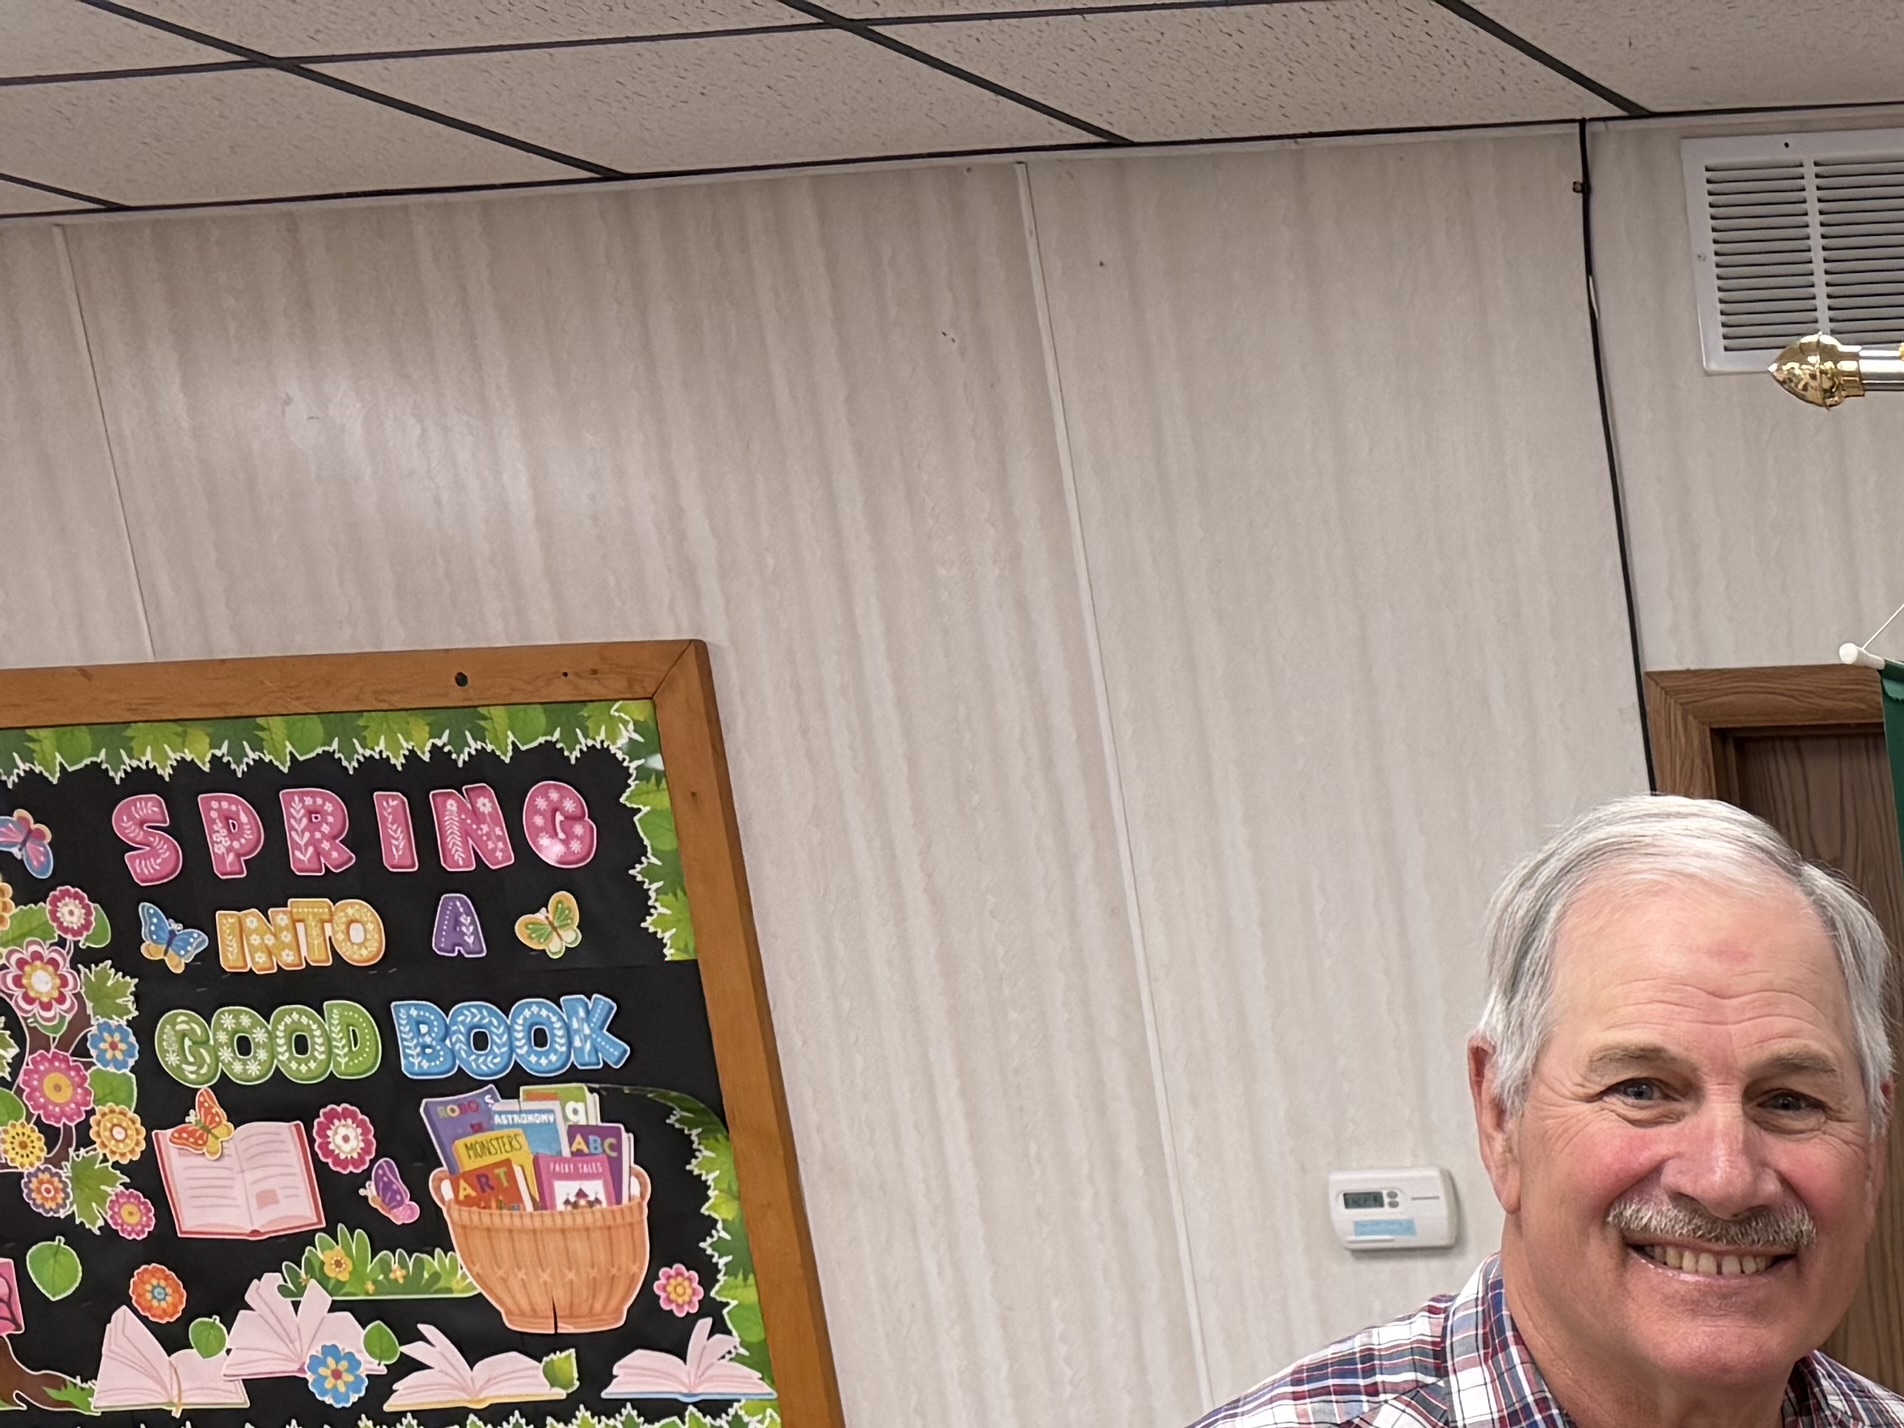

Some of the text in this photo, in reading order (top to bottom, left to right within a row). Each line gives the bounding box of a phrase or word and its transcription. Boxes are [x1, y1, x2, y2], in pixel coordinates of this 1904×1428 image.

[112, 781, 598, 885] SPRING
[215, 892, 488, 974] INTO A
[155, 993, 631, 1088] GOOD BOOK
[464, 1133, 523, 1161] MONSTERS
[571, 1133, 619, 1157] ABC
[458, 1167, 509, 1200] ART
